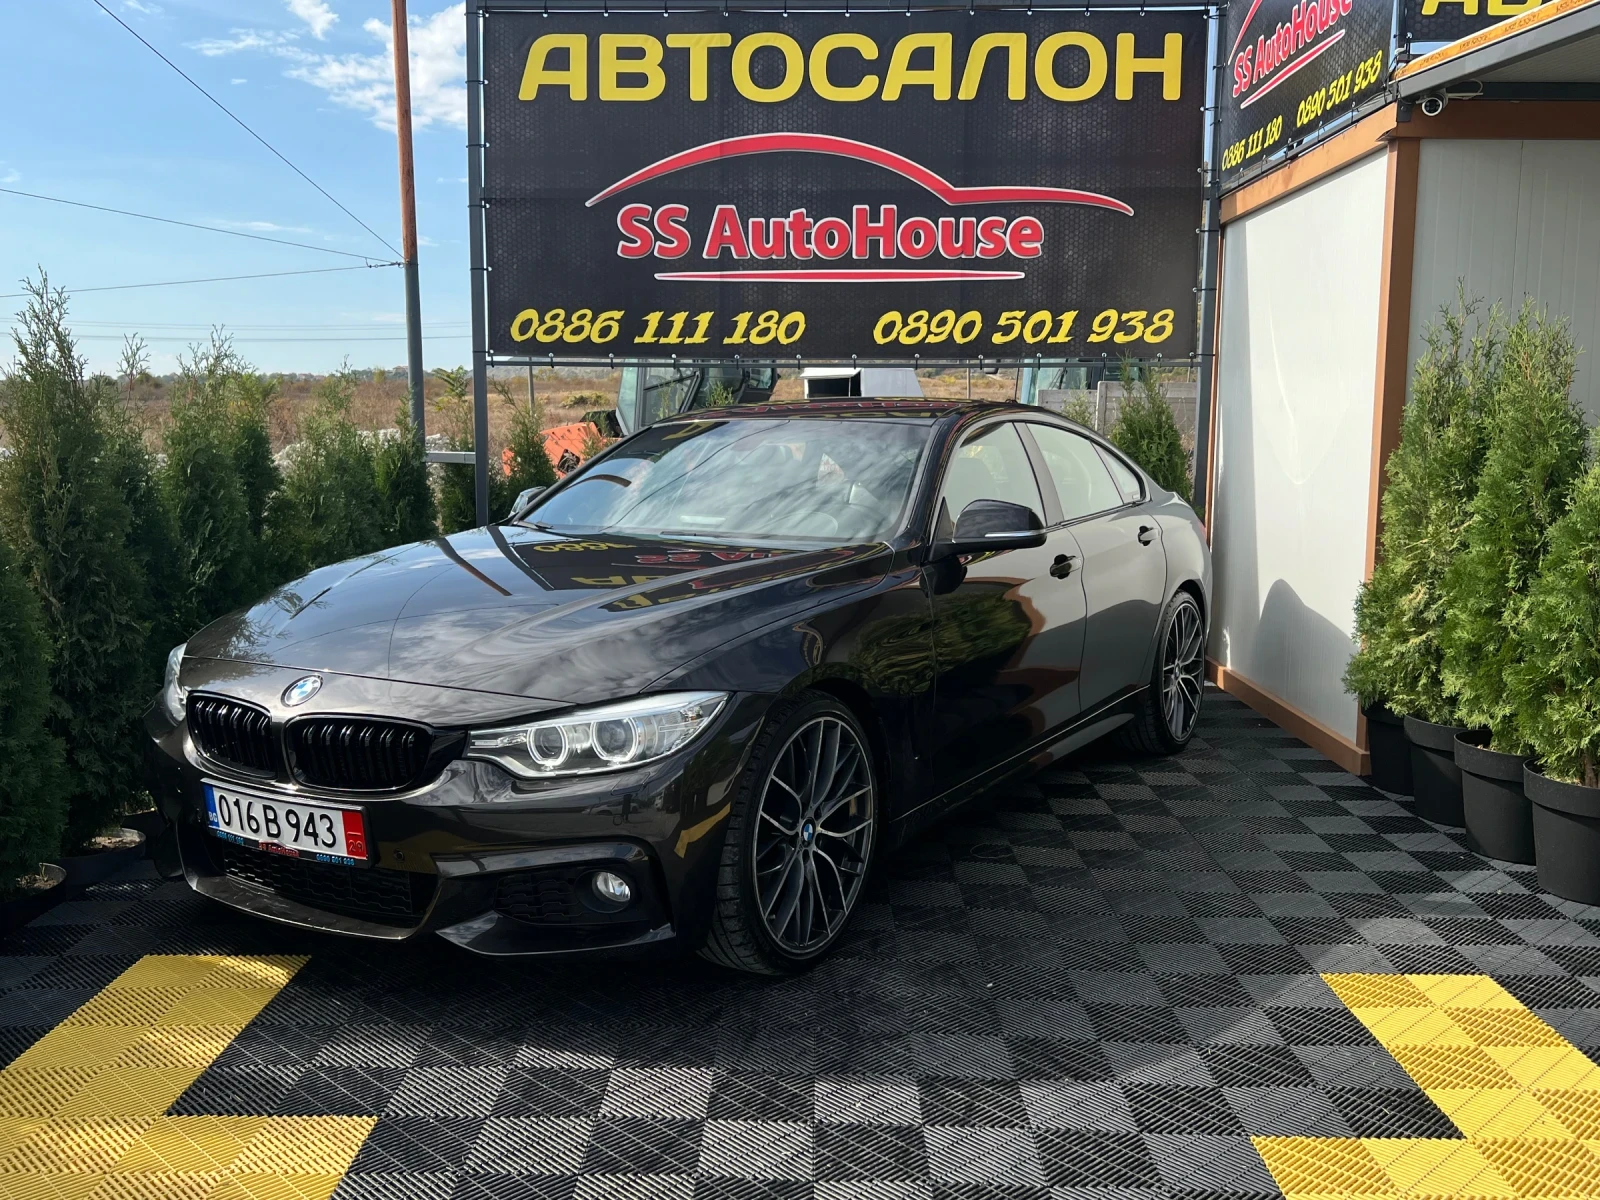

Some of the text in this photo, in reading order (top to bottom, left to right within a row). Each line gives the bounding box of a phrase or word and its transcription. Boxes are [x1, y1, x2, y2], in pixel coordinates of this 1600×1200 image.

[519, 31, 1183, 102] АВТОСАЛОН
[1233, 45, 1252, 97] SS
[1222, 138, 1245, 171] 0886
[1246, 127, 1265, 159] 111
[1264, 115, 1283, 149] 180
[1296, 87, 1326, 128] 0890
[1326, 70, 1353, 110] 501
[1354, 50, 1383, 93] 938
[617, 203, 1045, 260] SS AutoHouse
[511, 308, 1175, 345] 0886 111 180 0890 501 938
[208, 811, 218, 822] BG
[348, 839, 363, 853] 29
